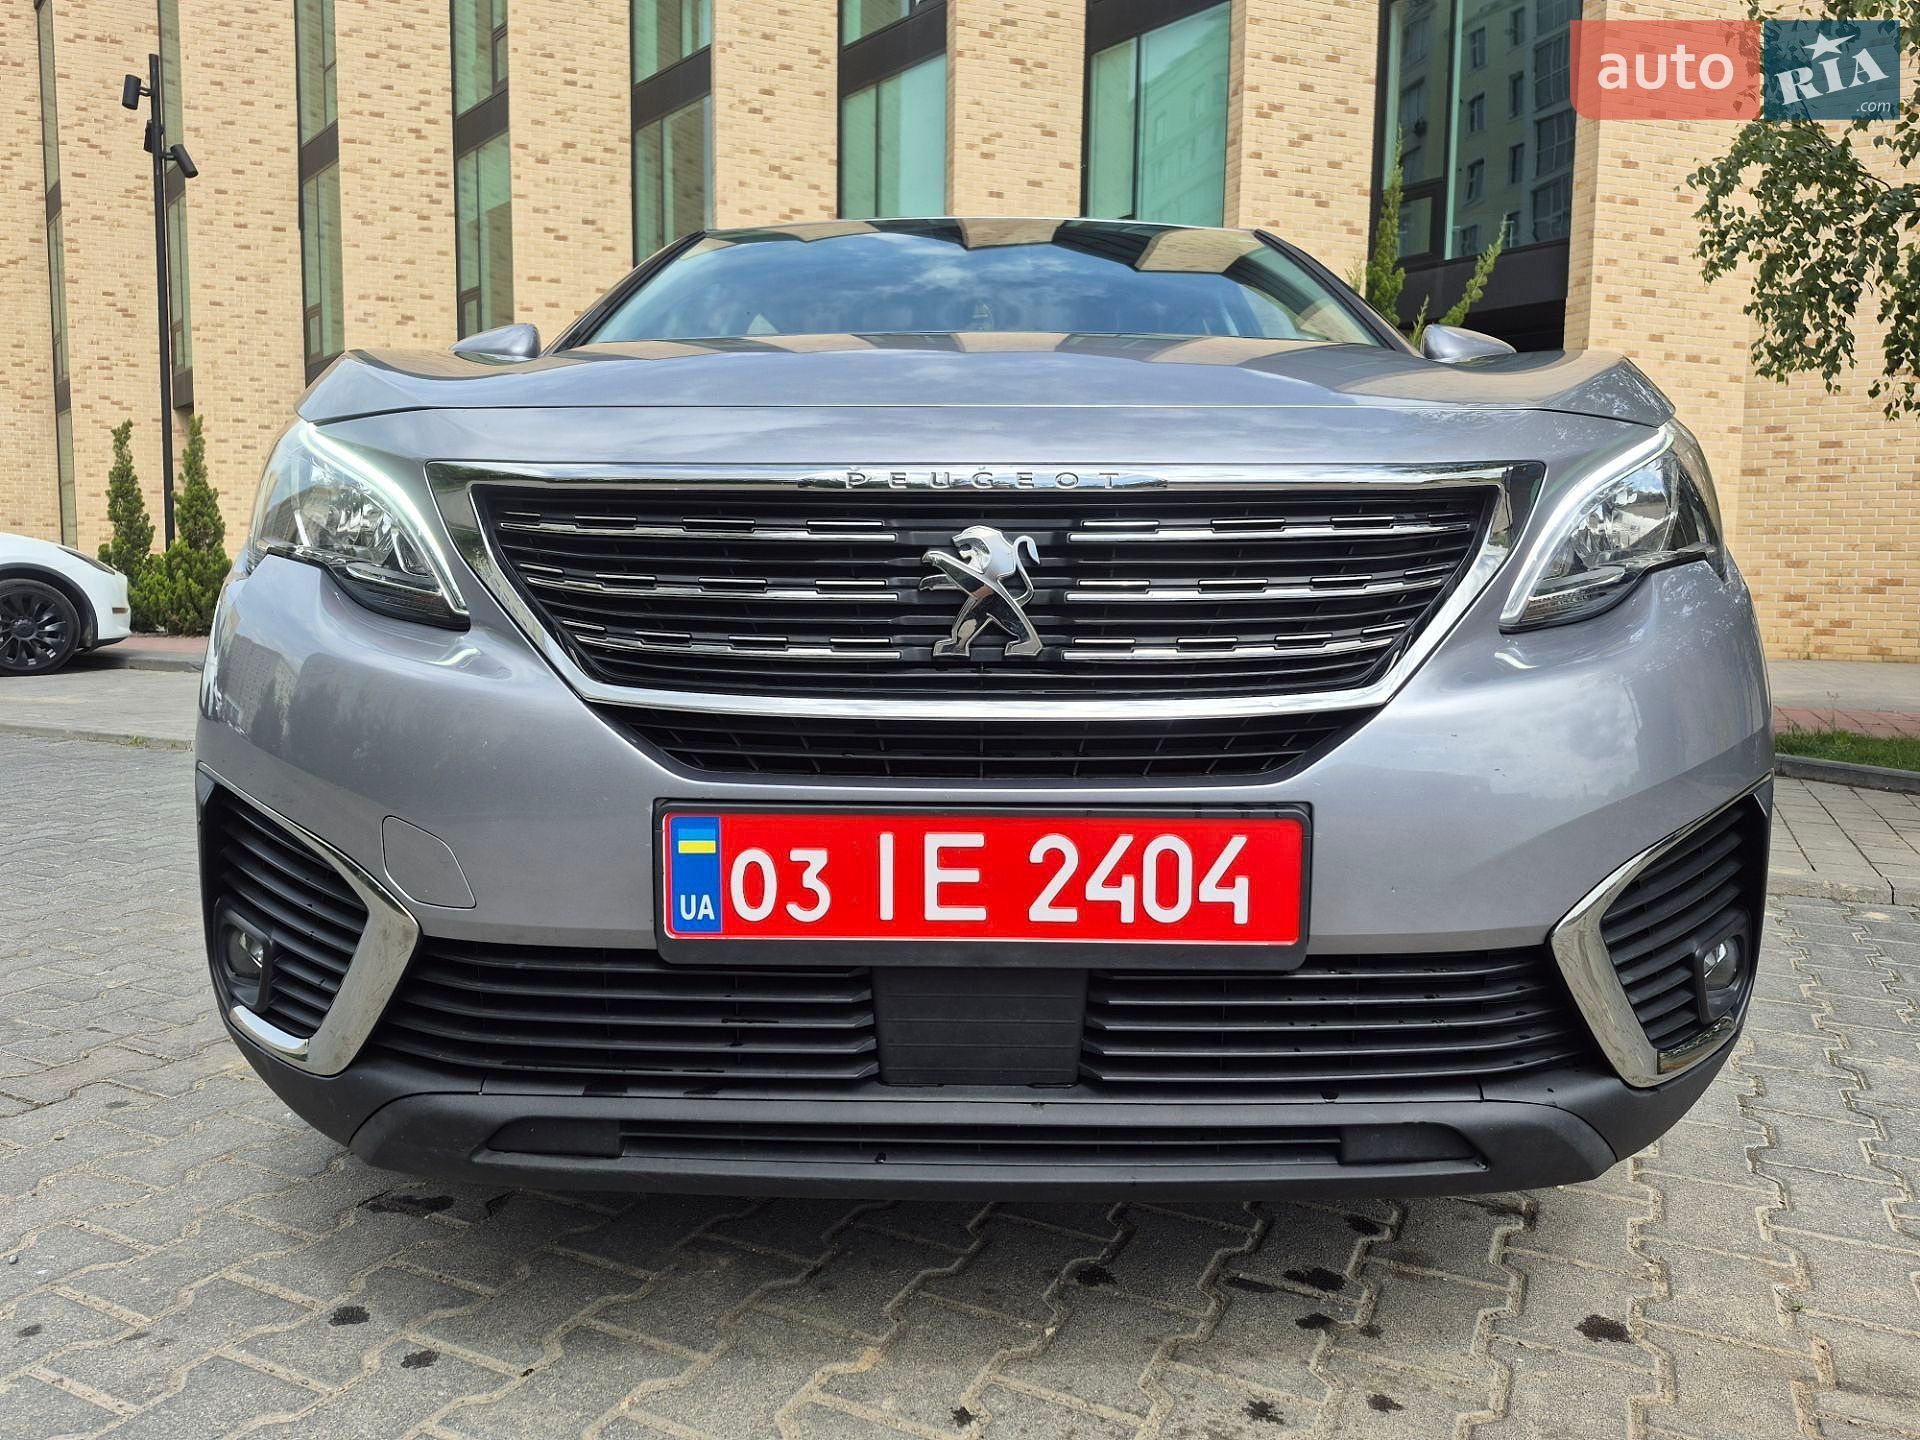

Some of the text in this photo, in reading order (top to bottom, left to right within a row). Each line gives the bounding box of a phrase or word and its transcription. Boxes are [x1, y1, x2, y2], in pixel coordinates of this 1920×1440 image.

[846, 471, 1120, 489] PEUGEOT
[729, 831, 1250, 925] 03 IE 2404
[680, 893, 716, 921] UA
